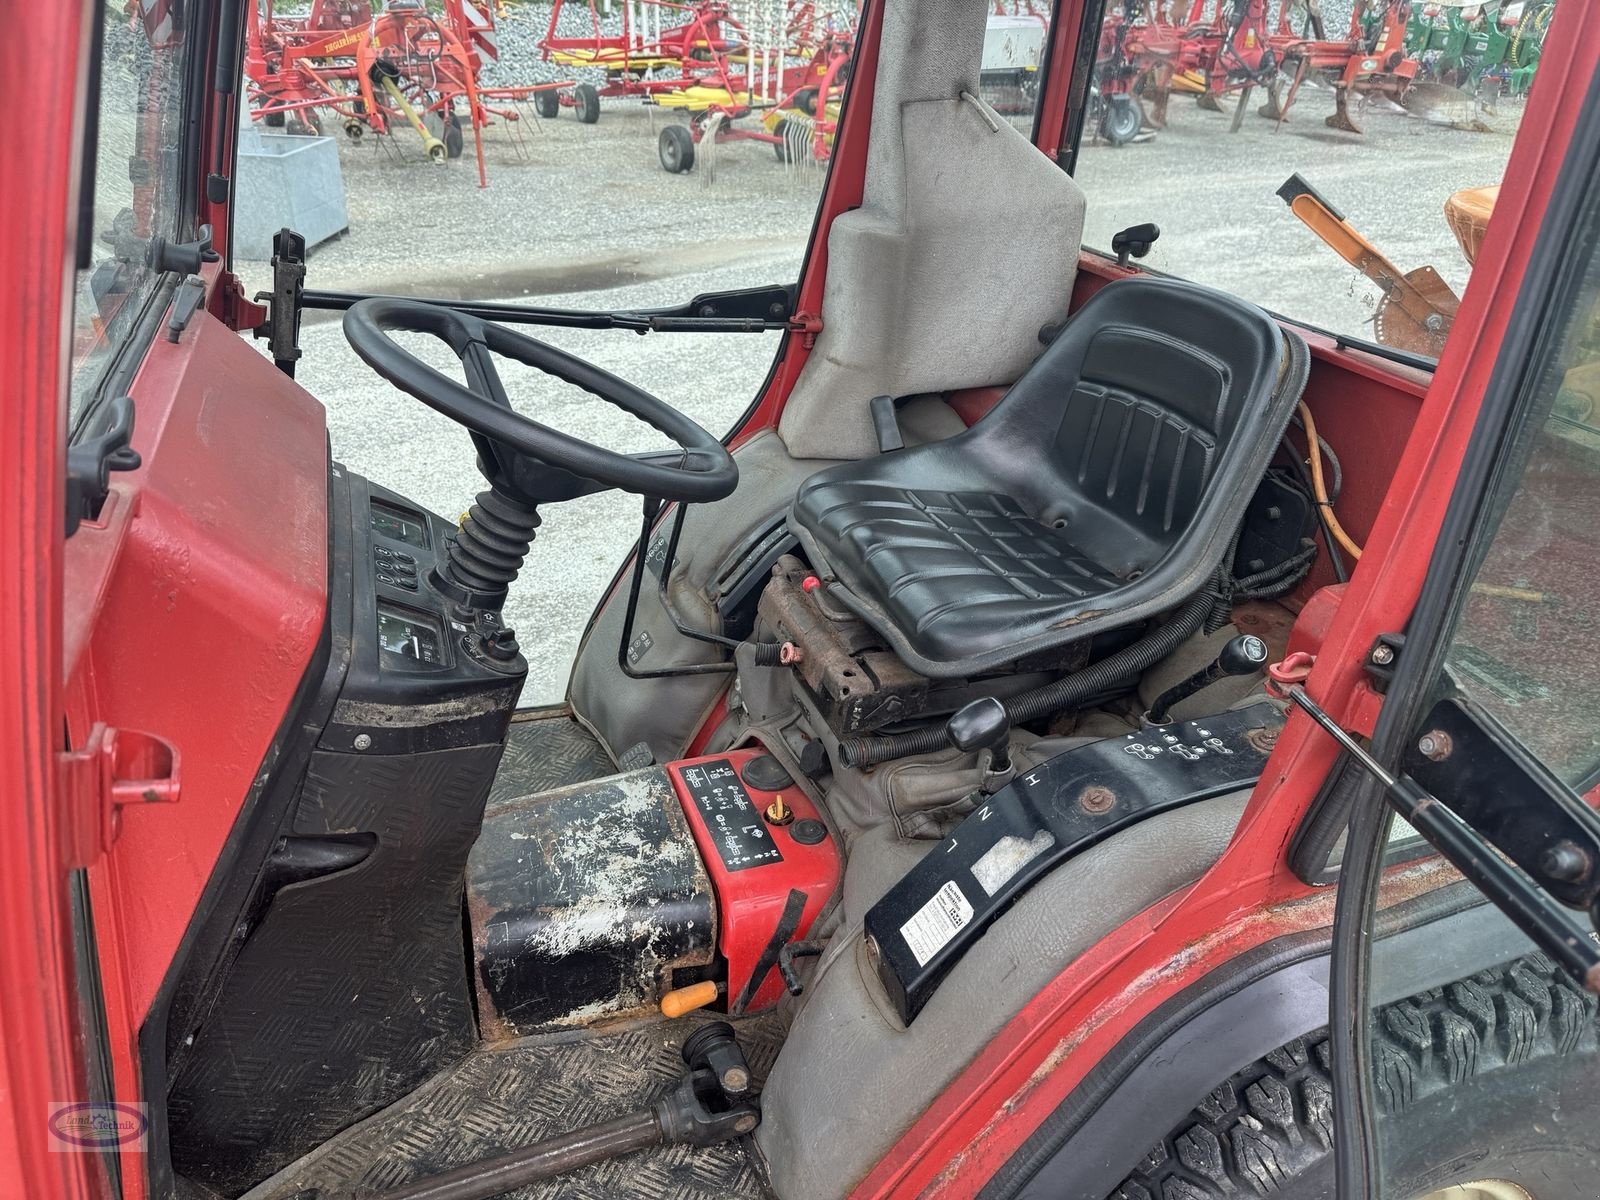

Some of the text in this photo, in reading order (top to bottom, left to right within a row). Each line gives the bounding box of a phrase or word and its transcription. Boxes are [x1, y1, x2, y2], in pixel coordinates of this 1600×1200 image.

[1025, 773, 1041, 787] H
[978, 806, 993, 821] N
[947, 838, 958, 853] L
[943, 888, 961, 911] Inspektion
